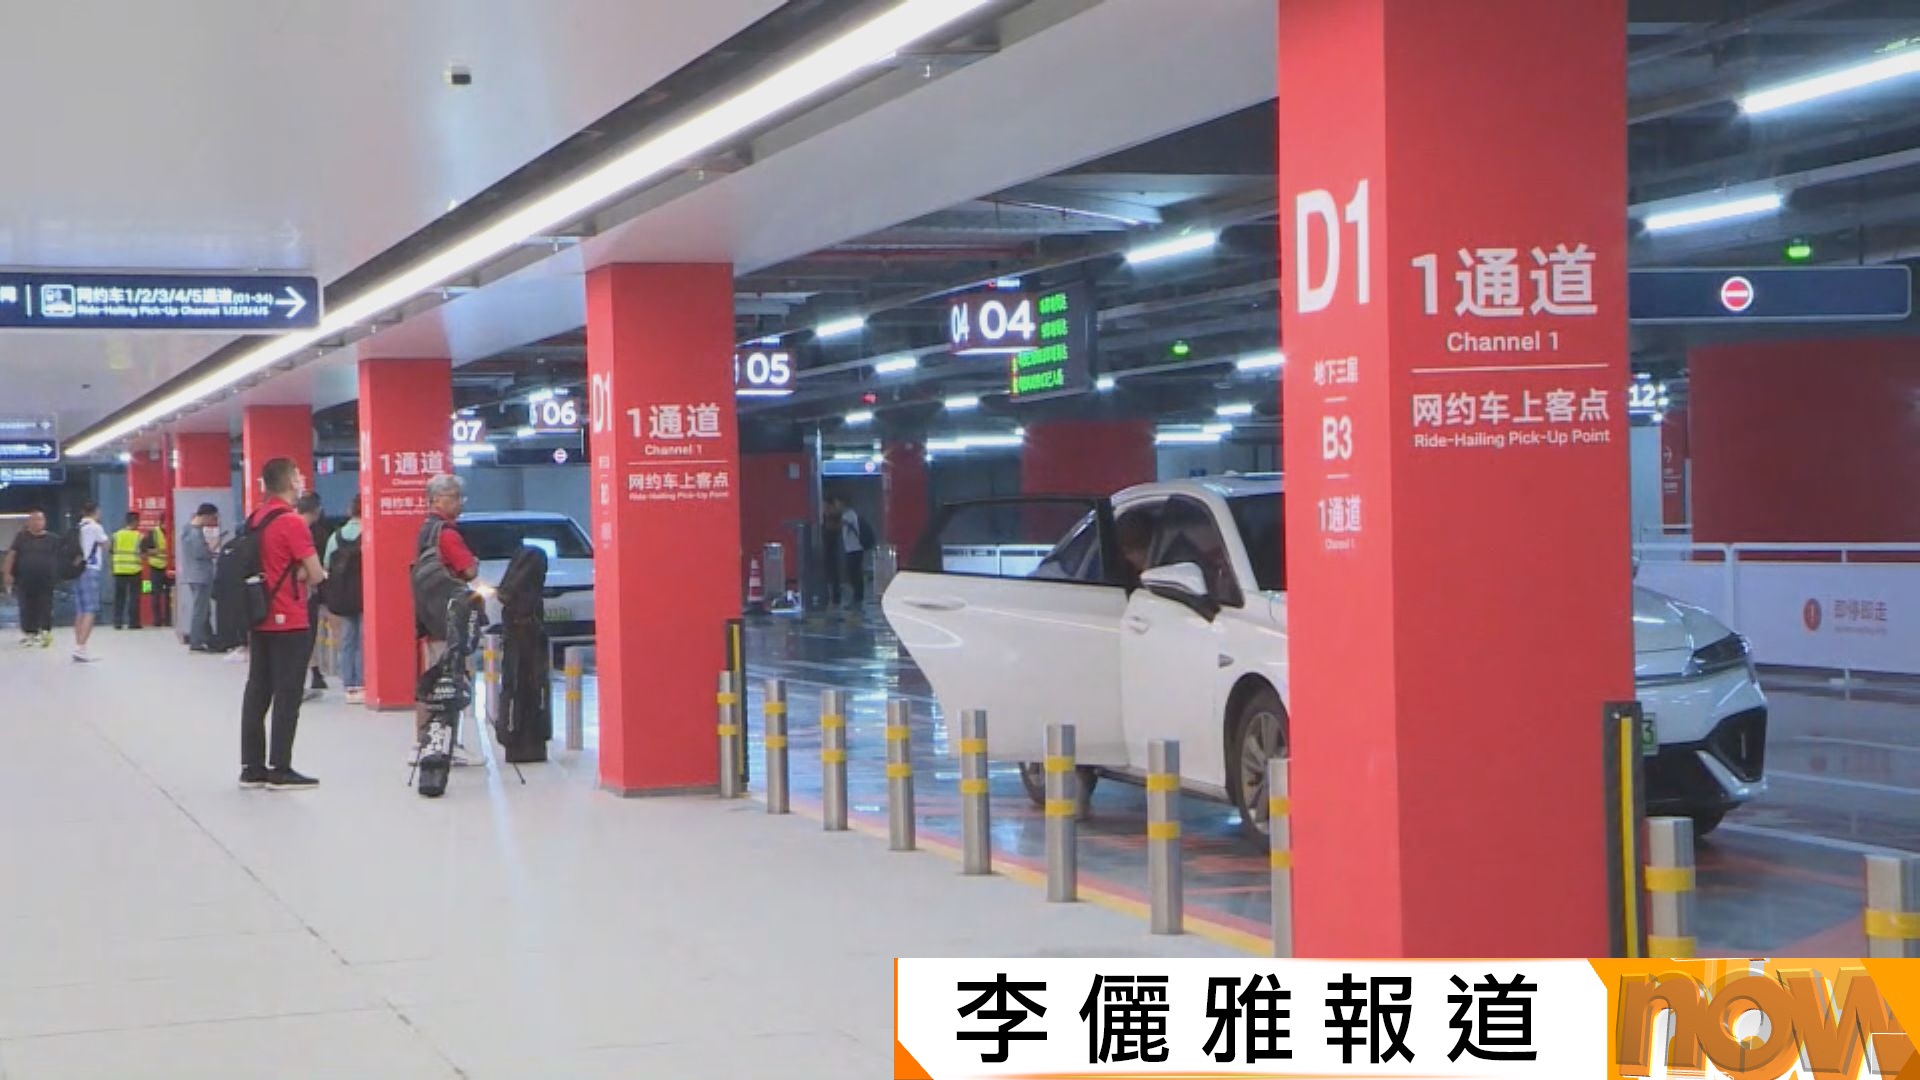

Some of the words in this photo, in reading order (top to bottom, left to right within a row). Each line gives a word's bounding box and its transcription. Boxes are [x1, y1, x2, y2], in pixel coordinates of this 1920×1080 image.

[1296, 179, 1370, 314] D1
[1411, 243, 1598, 317] 1通道
[979, 299, 1036, 340] 04
[1447, 331, 1540, 353] Channel
[1549, 331, 1559, 351] 1
[747, 352, 790, 385] 05
[1412, 388, 1610, 428] 网约车上客点
[1628, 384, 1656, 407] 12
[543, 400, 577, 425] 06
[627, 403, 722, 439] 1通道
[453, 420, 482, 441] 07
[1322, 415, 1352, 459] B3
[1415, 432, 1504, 449] Ride-Hailing
[1509, 429, 1568, 446] Pick-Up
[1572, 428, 1611, 444] Point
[645, 443, 692, 455] Channel
[628, 471, 729, 491] 网约车上客点
[1318, 494, 1362, 534] 1通道
